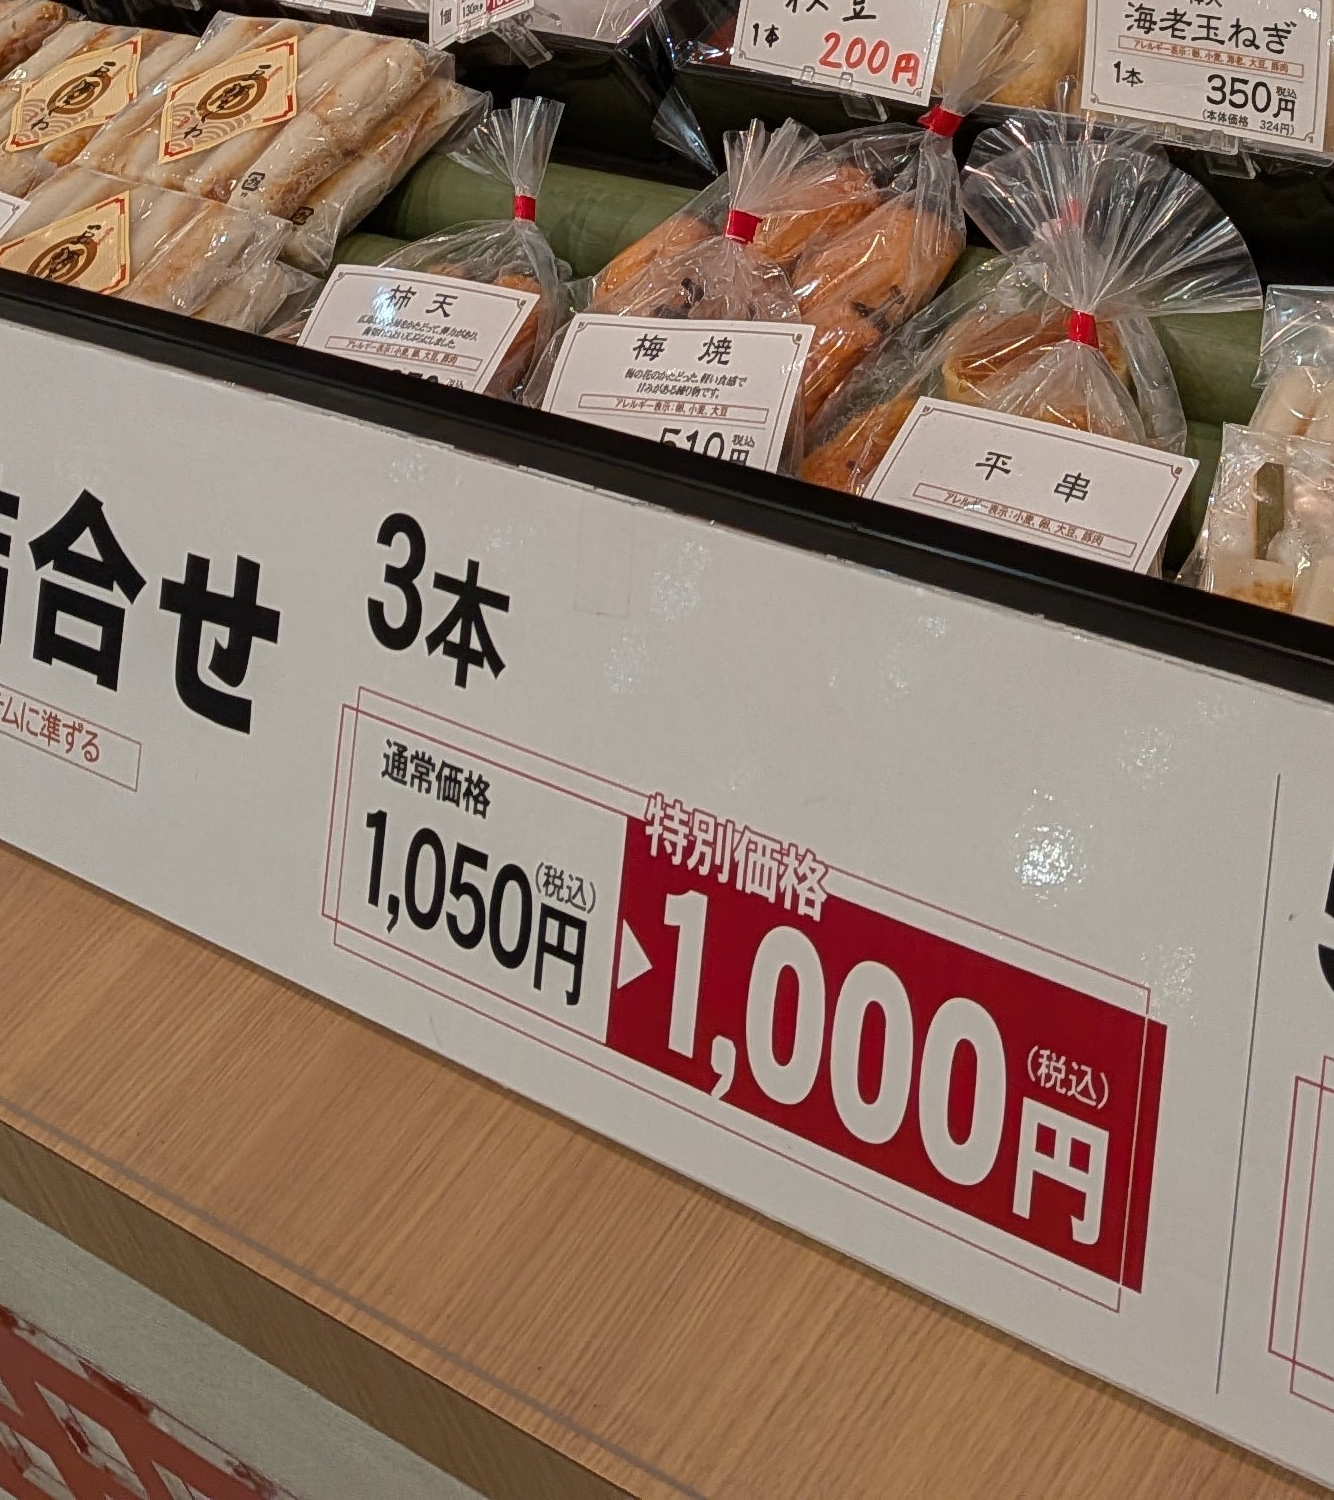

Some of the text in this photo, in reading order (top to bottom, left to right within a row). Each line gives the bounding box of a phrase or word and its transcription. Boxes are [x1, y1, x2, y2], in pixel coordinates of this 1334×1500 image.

[752, 22, 921, 88] 1本 200円
[1124, 1, 1298, 55] 海老玉ねぎ
[1113, 60, 1145, 88] 1本
[1205, 73, 1297, 123] 350円
[1201, 108, 1296, 136] (本体価格 324円)
[632, 332, 733, 367] 梅焼
[974, 450, 1091, 505] 平串
[367, 512, 511, 690] 3本
[381, 737, 492, 822] 通常価格
[643, 792, 830, 922] 特別価格
[362, 808, 597, 1008] 1,050円 (税込)
[662, 890, 1111, 1248] 1,000円 (税込)
